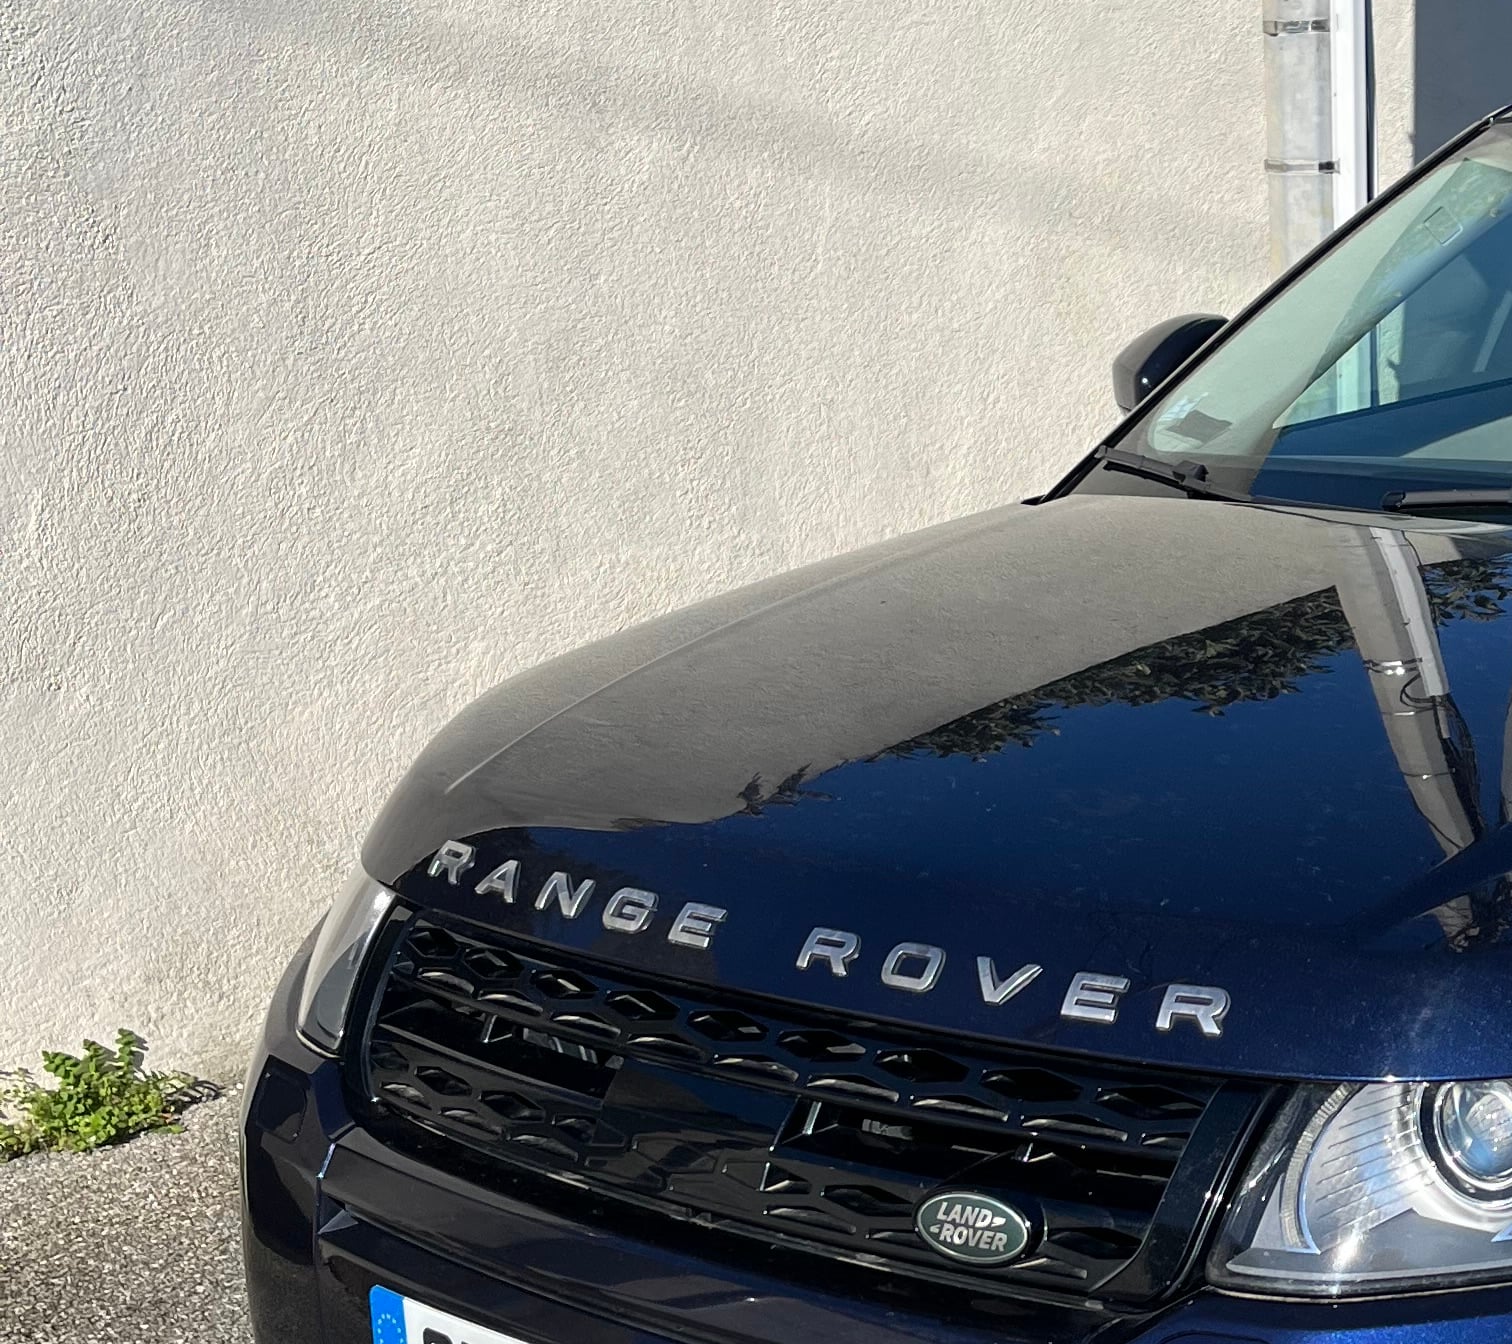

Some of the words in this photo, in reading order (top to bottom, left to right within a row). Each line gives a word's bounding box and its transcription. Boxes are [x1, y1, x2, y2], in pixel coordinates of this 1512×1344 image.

[427, 839, 728, 949] RANGE
[796, 926, 1231, 1038] ROVER
[936, 1201, 993, 1228] LAND
[939, 1223, 1008, 1252] ROVER
